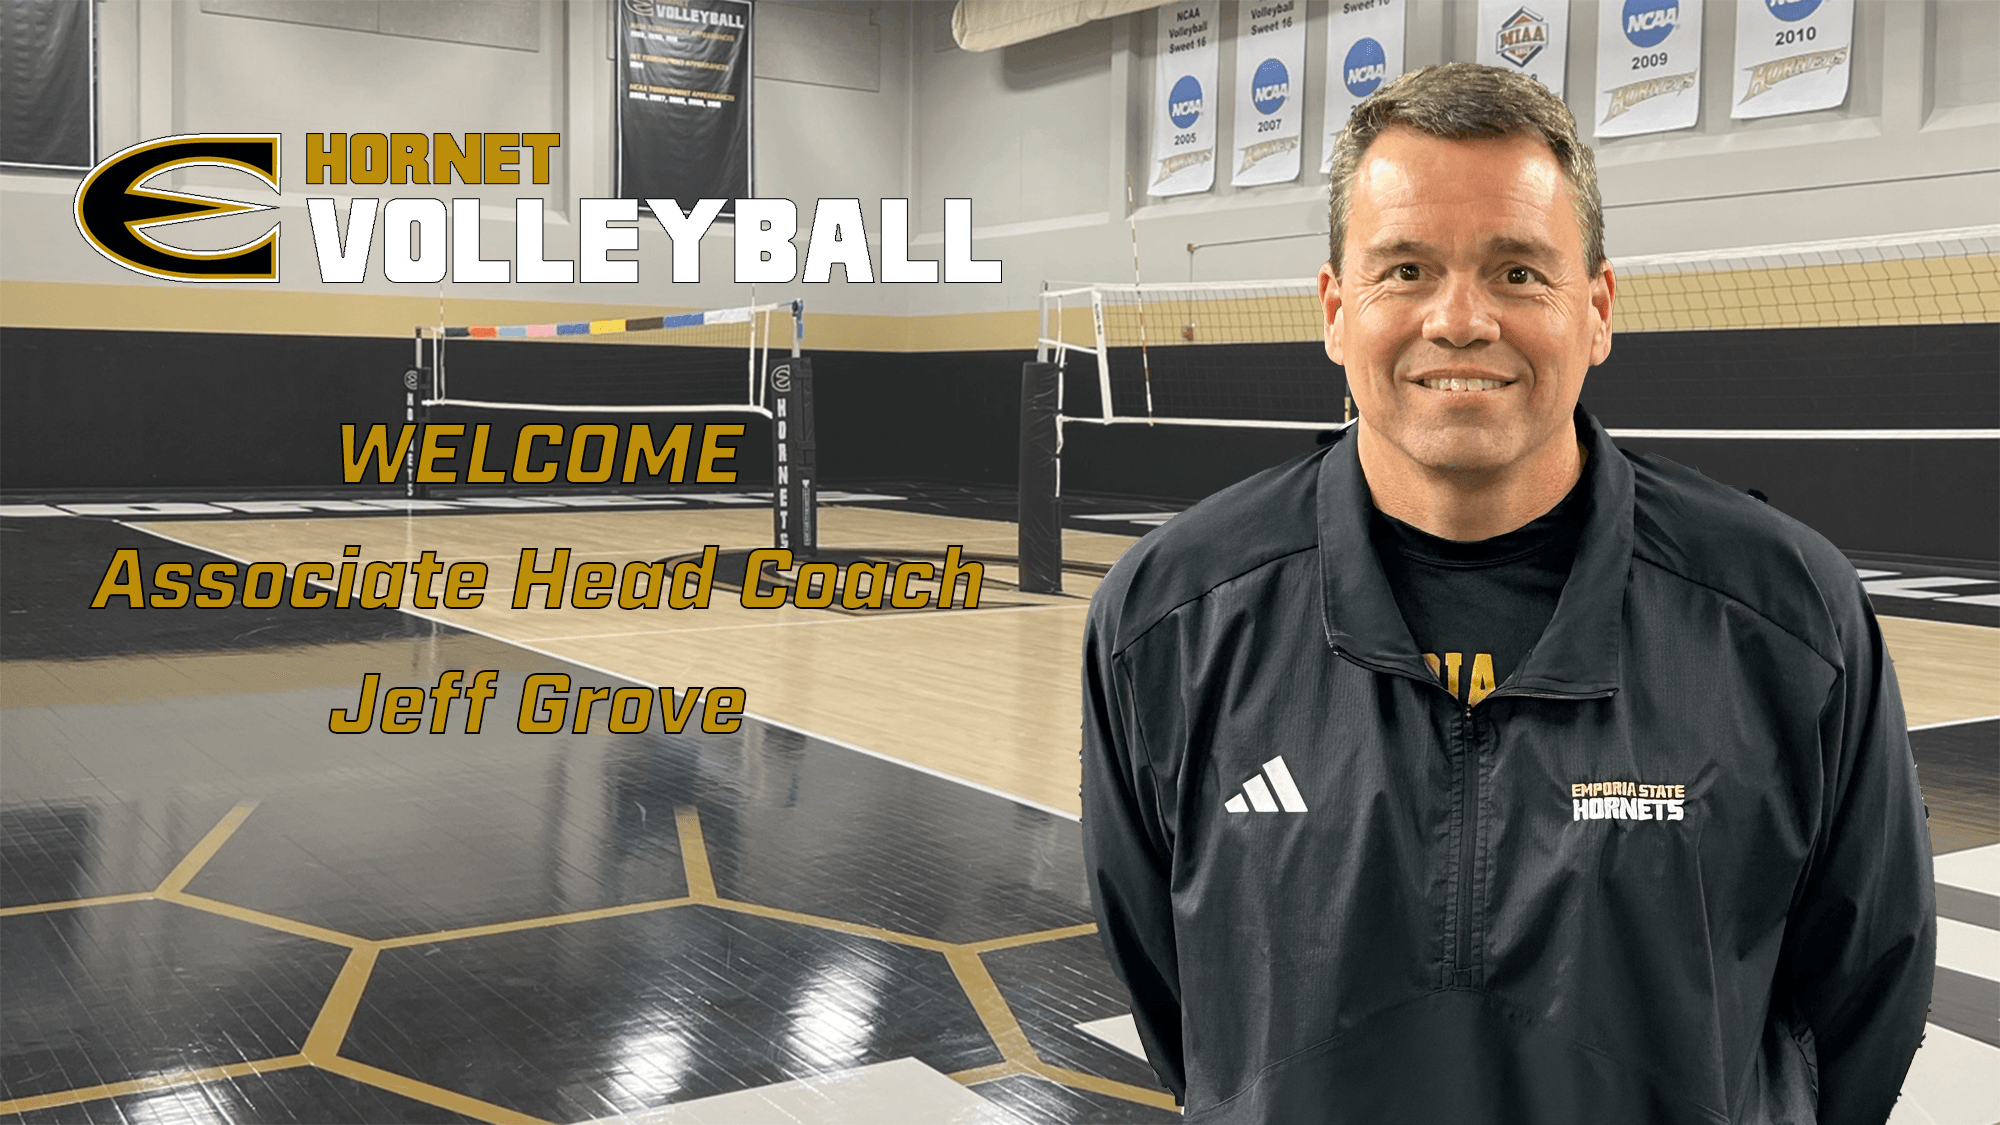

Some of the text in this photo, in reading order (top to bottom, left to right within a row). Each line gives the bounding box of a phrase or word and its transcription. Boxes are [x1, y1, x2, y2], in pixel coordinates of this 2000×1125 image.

[656, 4, 744, 29] VOLLEYBALL
[1177, 7, 1200, 22] NCAA
[1251, 0, 1294, 19] Volleyball
[1169, 20, 1208, 39] Volleyball
[1251, 16, 1293, 35] Sweet 16
[1627, 8, 1680, 33] NCAA
[1169, 36, 1207, 54] Sweet 16
[1500, 26, 1545, 49] MIAA
[1775, 26, 1816, 46] 2010
[1632, 52, 1668, 70] 2009
[1347, 63, 1386, 85] NCAA
[1255, 83, 1289, 103] NCAA
[1172, 99, 1203, 118] NCAA
[1257, 119, 1282, 133] 2007
[1174, 133, 1197, 146] 2005
[406, 392, 415, 497] HOETS
[777, 398, 789, 549] HORNETS
[1571, 781, 1685, 798] EMPORIA STATE
[1572, 797, 1685, 821] HORNETS
